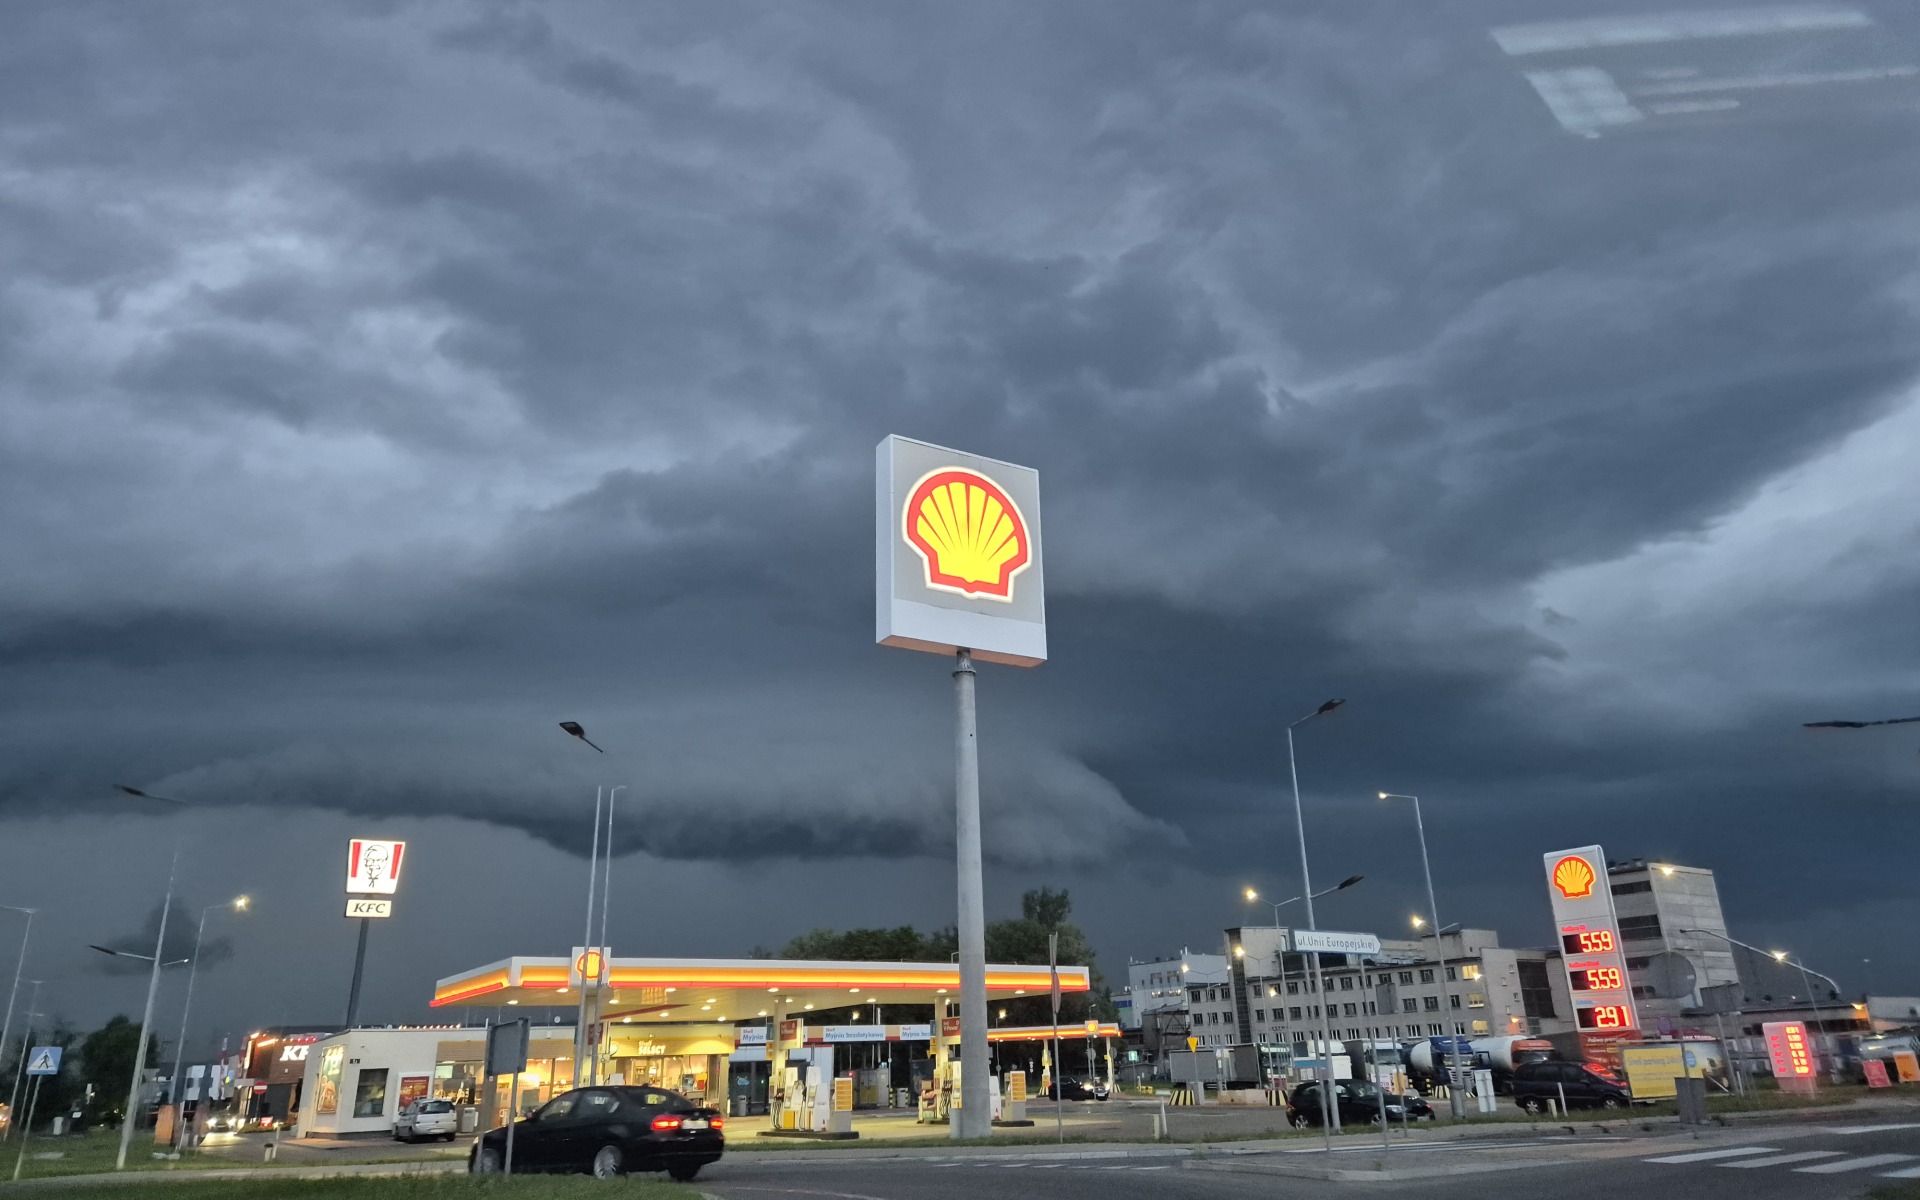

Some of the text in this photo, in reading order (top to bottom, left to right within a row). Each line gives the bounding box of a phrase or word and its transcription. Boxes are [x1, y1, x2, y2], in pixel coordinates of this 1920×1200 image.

[353, 902, 386, 914] KFC
[1326, 936, 1375, 952] Europejskiej
[742, 1033, 764, 1042] Myjnia
[280, 1045, 309, 1061] KF
[638, 1045, 666, 1055] SELECT
